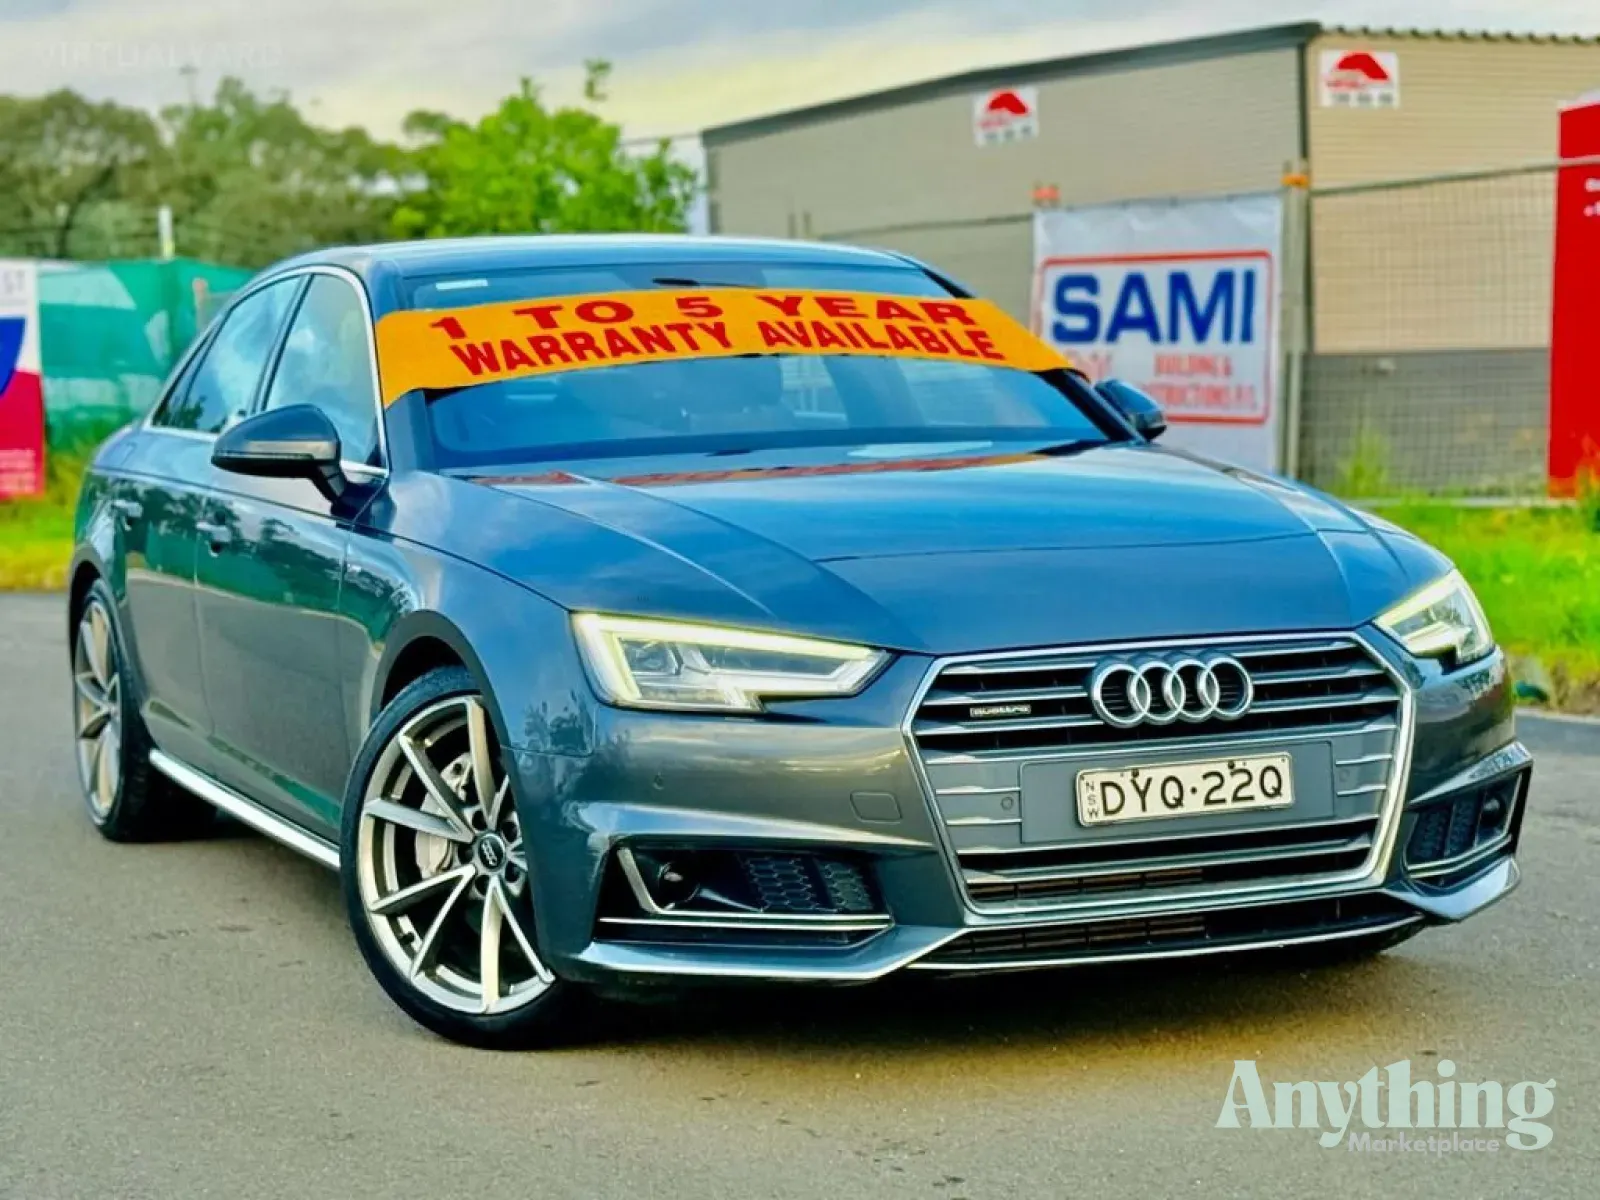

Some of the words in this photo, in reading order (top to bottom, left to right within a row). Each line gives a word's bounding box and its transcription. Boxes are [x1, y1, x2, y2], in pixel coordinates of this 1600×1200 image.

[430, 316, 467, 339] 1
[512, 300, 634, 330] TO
[676, 296, 724, 318] 5
[756, 296, 977, 325] YEAR
[1052, 269, 1256, 343] SAMI
[449, 322, 733, 376] WARRANTY
[757, 321, 1005, 360] AVAILABLE
